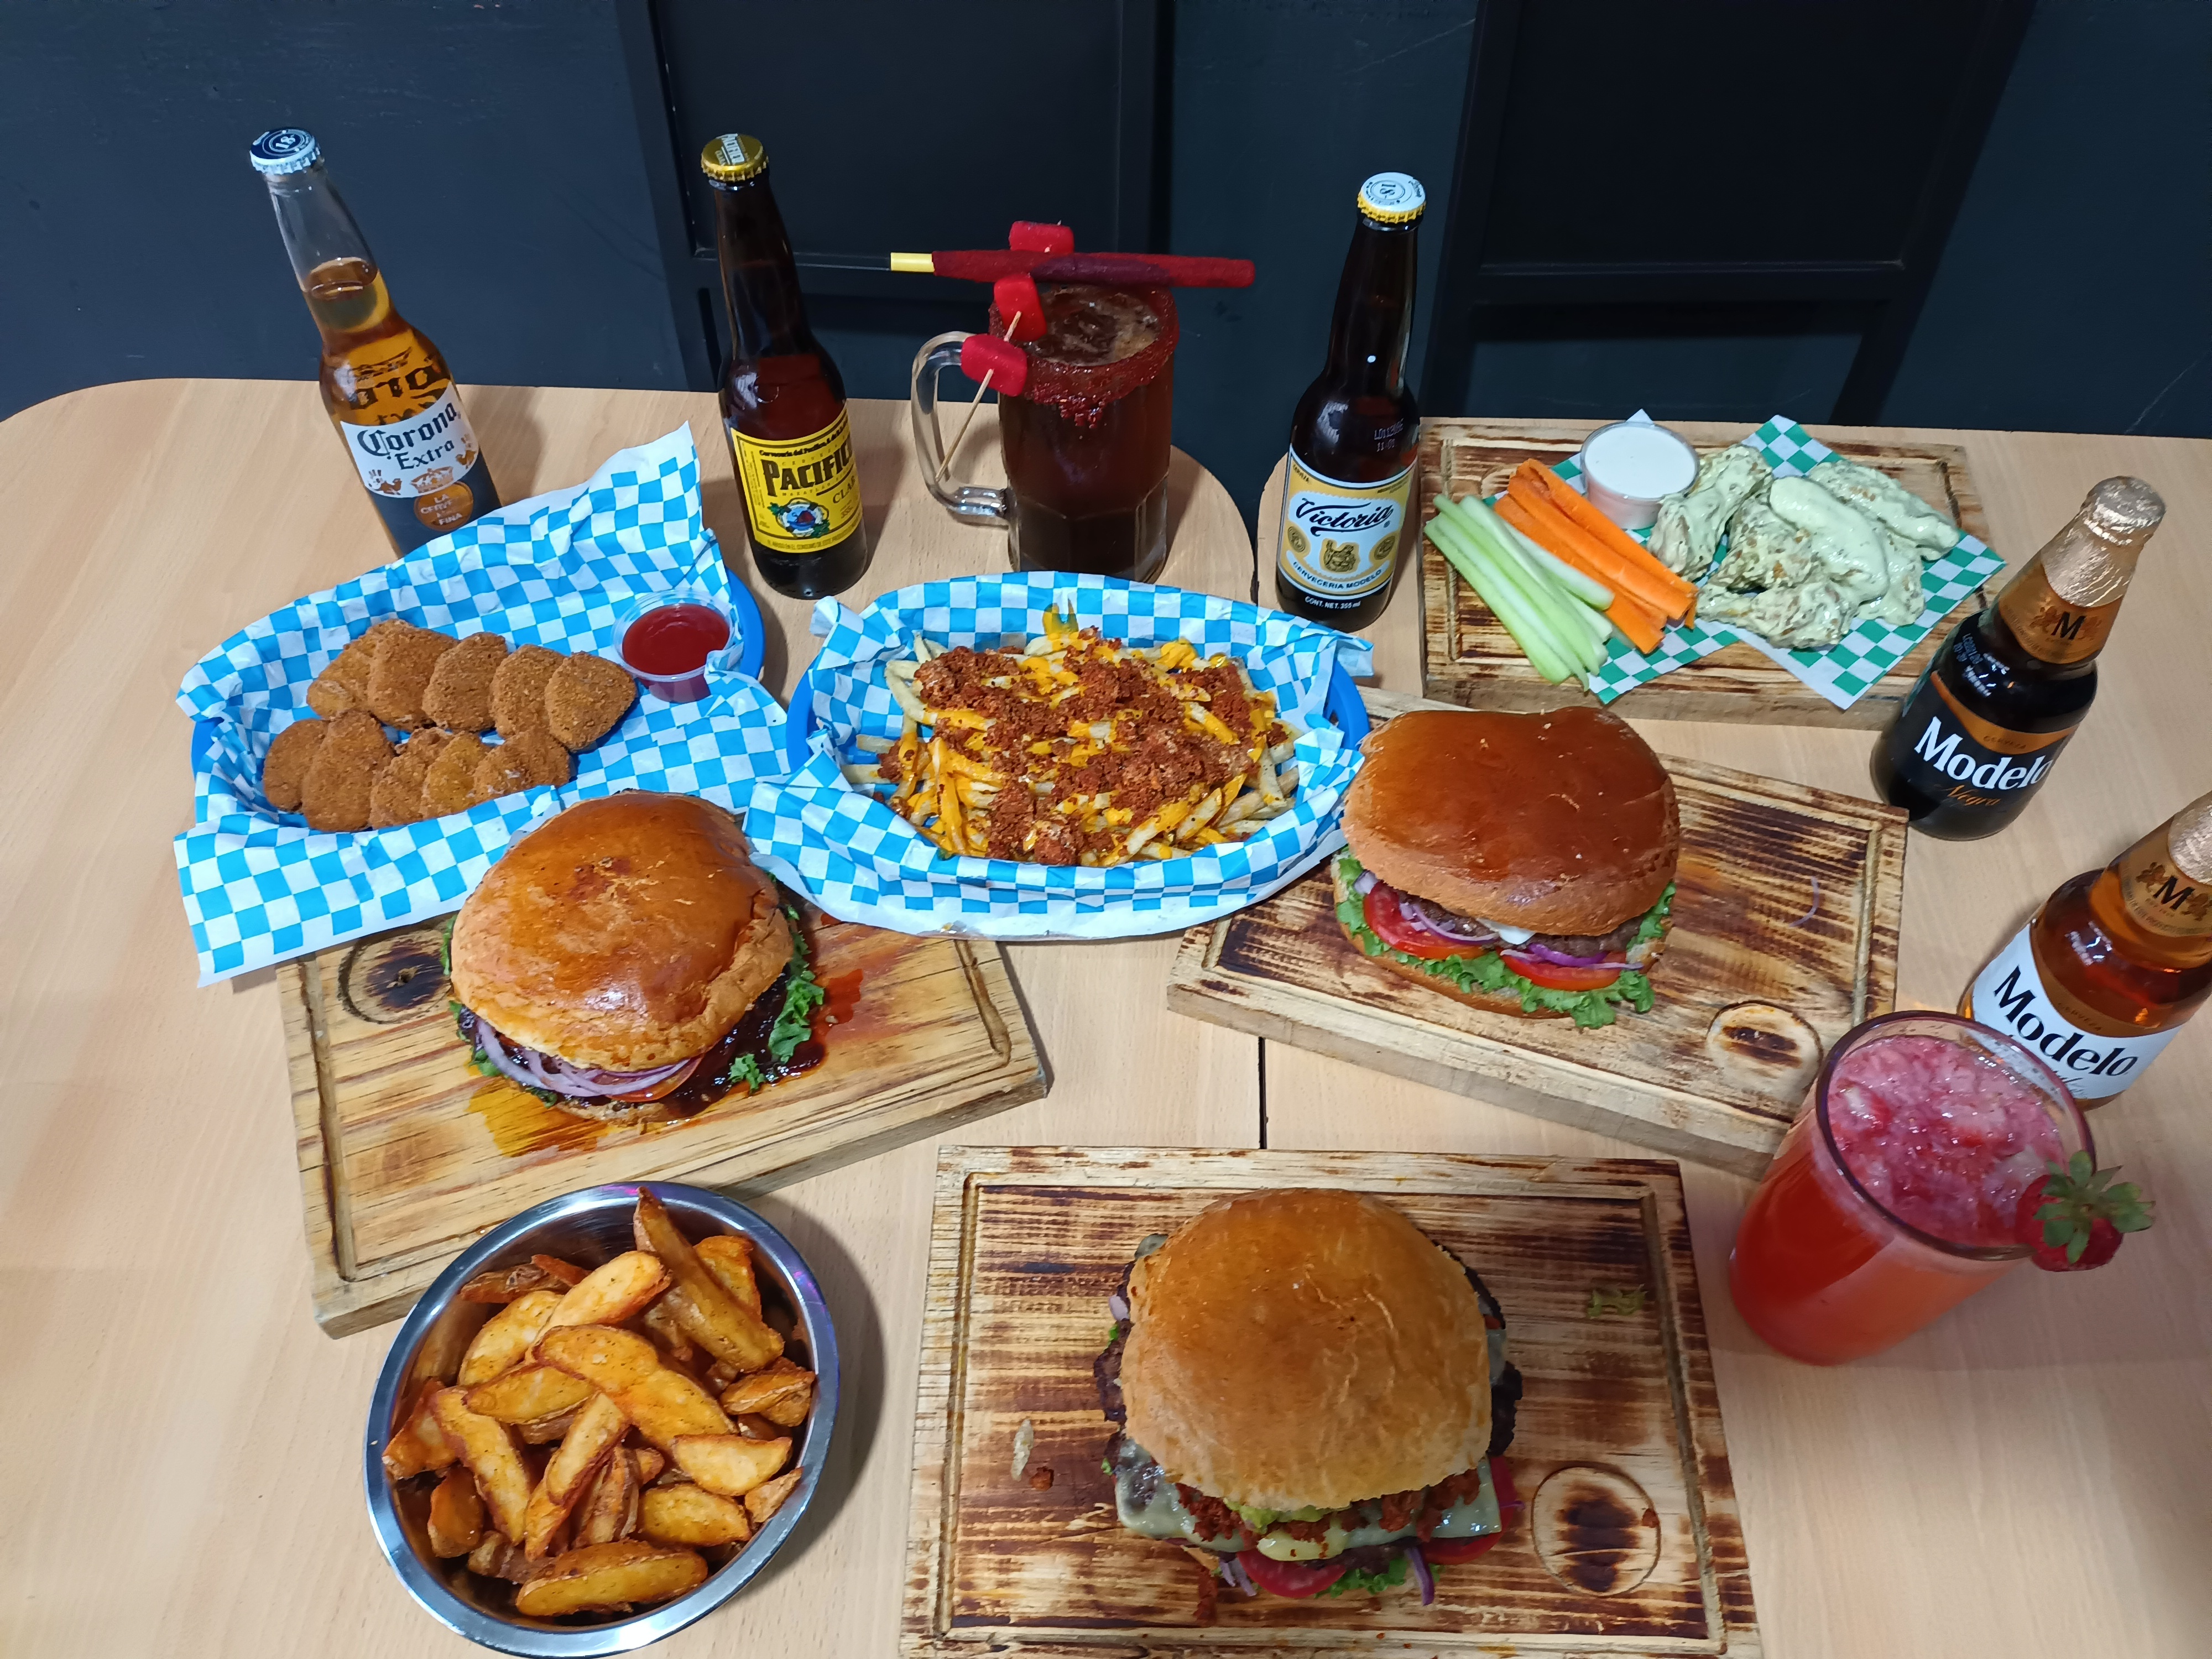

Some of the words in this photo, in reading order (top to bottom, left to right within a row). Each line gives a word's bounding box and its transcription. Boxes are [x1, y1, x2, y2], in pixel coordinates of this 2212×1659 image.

[357, 402, 458, 460] Corona
[395, 440, 455, 469] Extra
[1296, 498, 1394, 536] Victoria
[2051, 611, 2086, 640] M
[1914, 716, 2053, 790] Modelo
[2153, 875, 2195, 910] M
[1994, 964, 2138, 1076] Modelo
